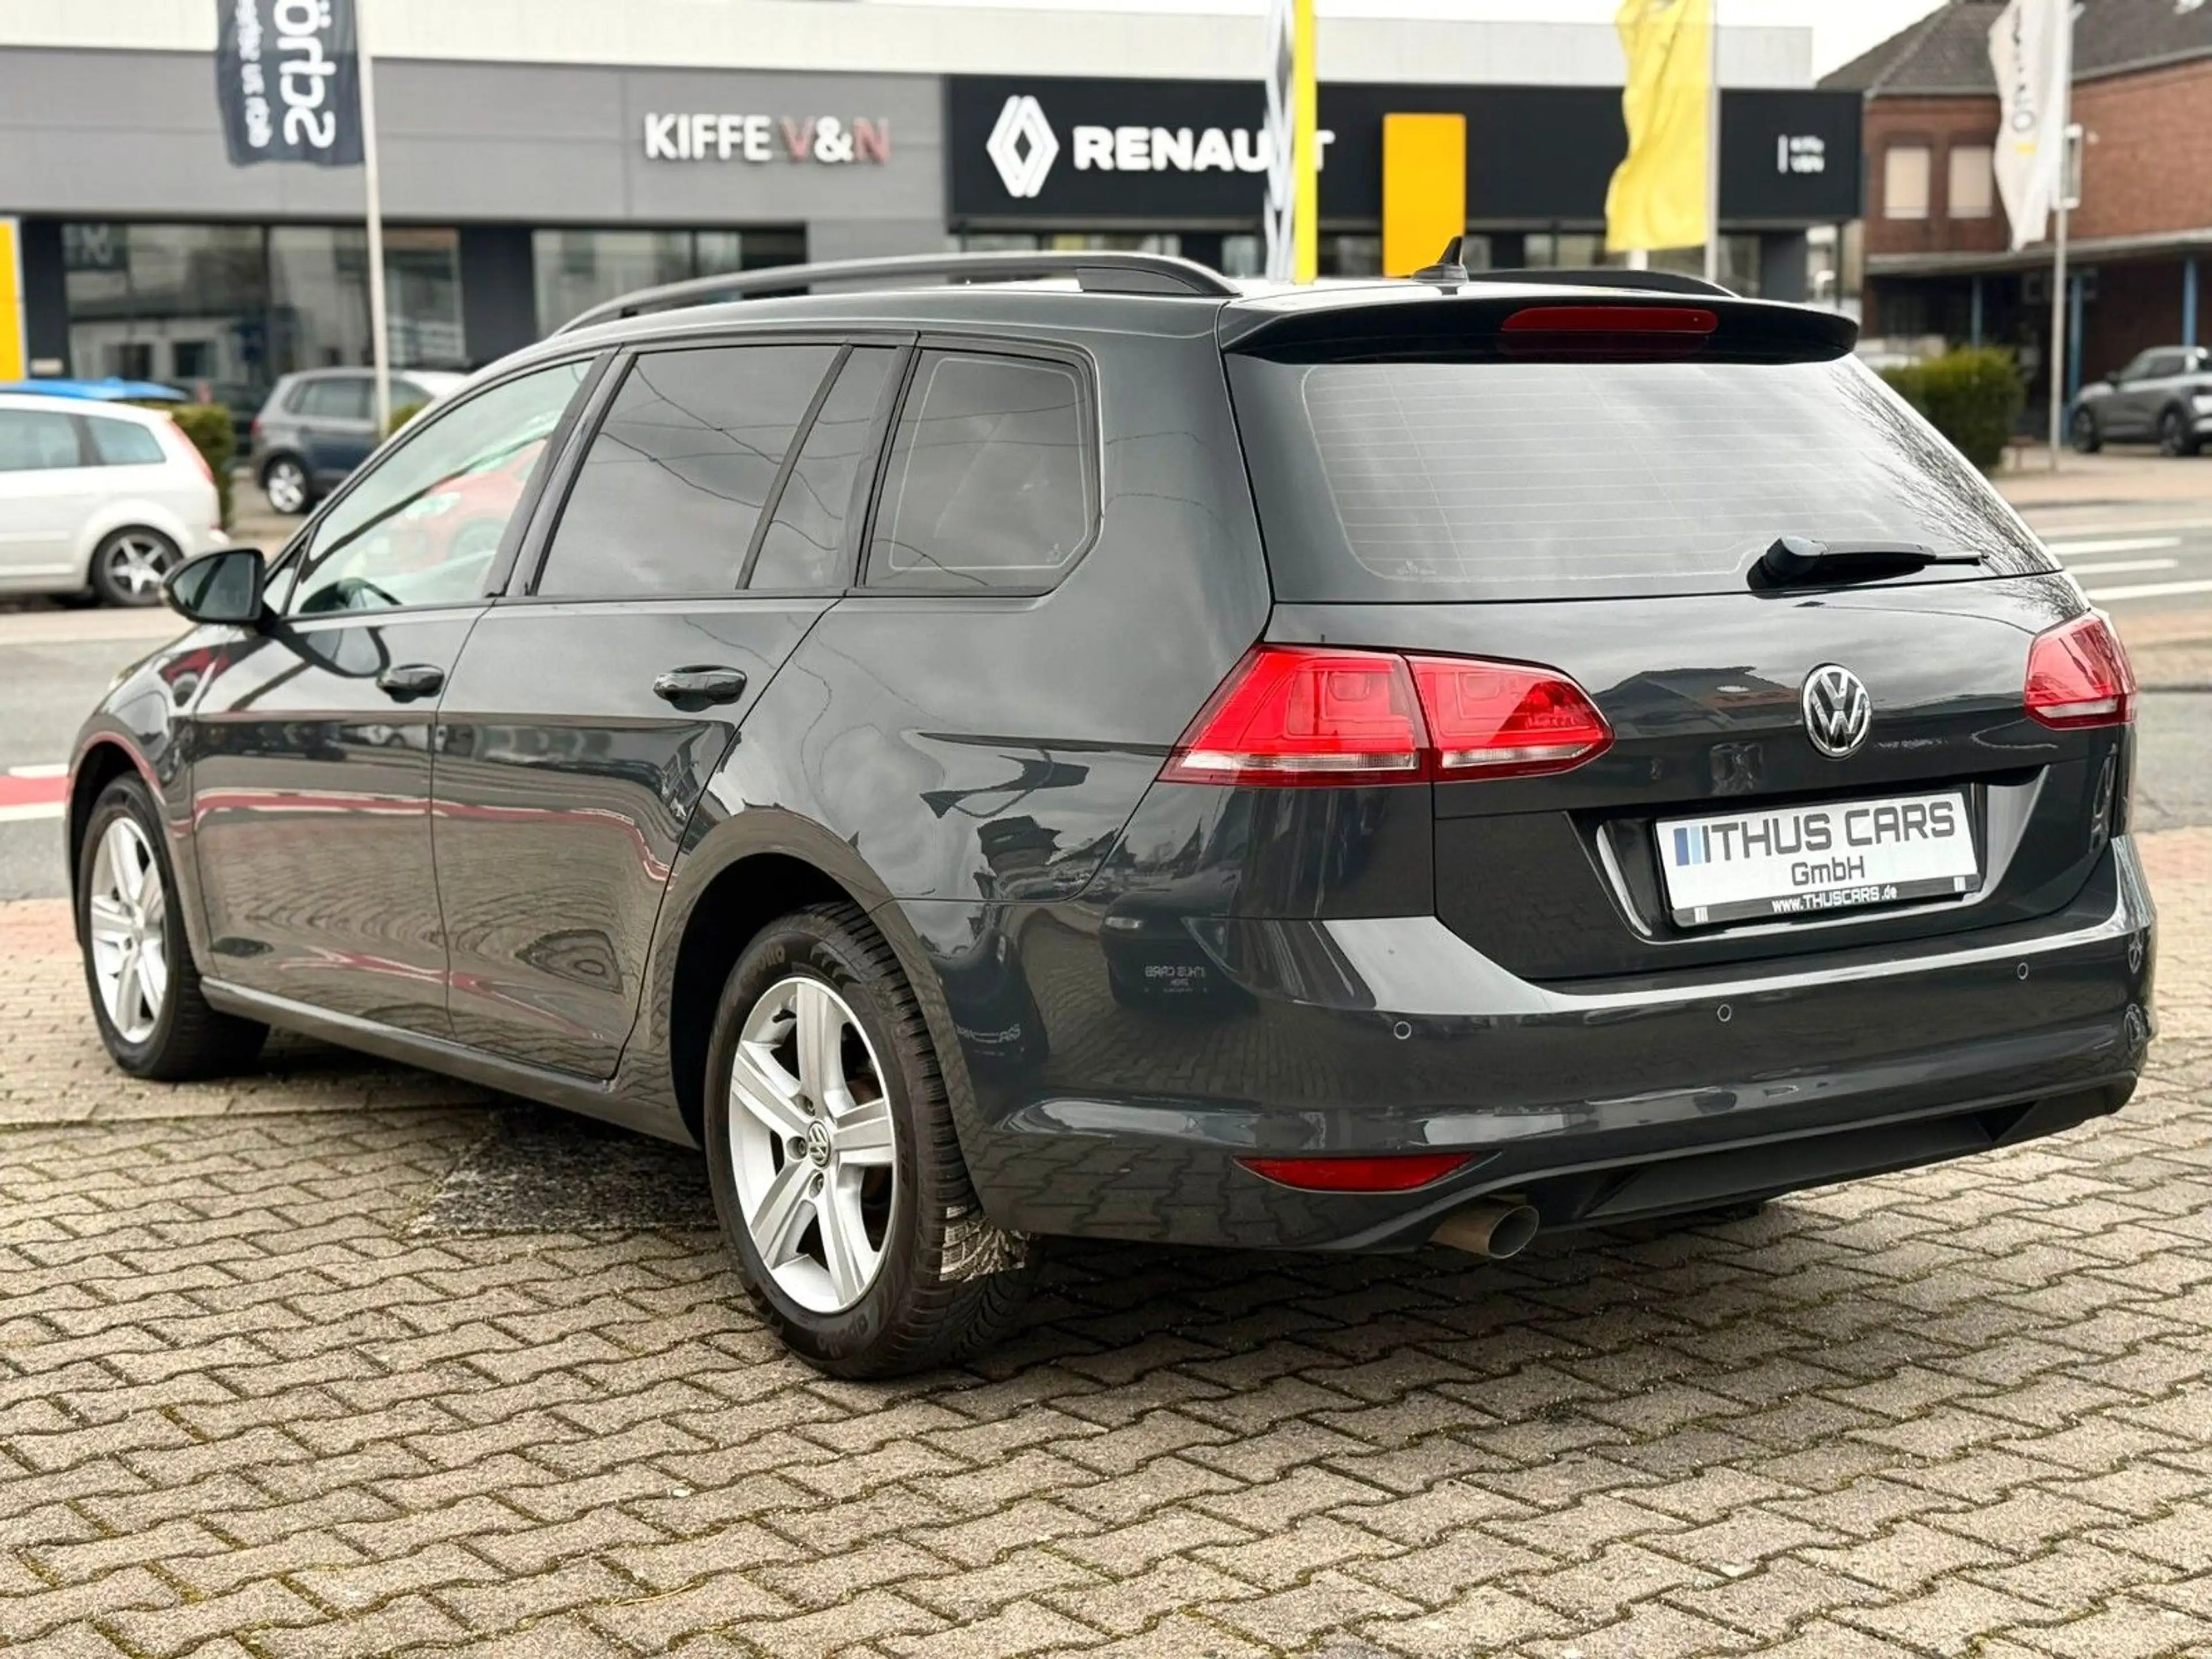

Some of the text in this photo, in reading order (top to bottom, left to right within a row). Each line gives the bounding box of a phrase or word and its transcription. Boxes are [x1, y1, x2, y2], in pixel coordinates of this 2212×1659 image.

[645, 112, 891, 165] KIFFE V&N
[1073, 126, 1336, 172] RENAUT
[1846, 801, 1955, 846] CARS
[1791, 856, 1865, 886] GmbH
